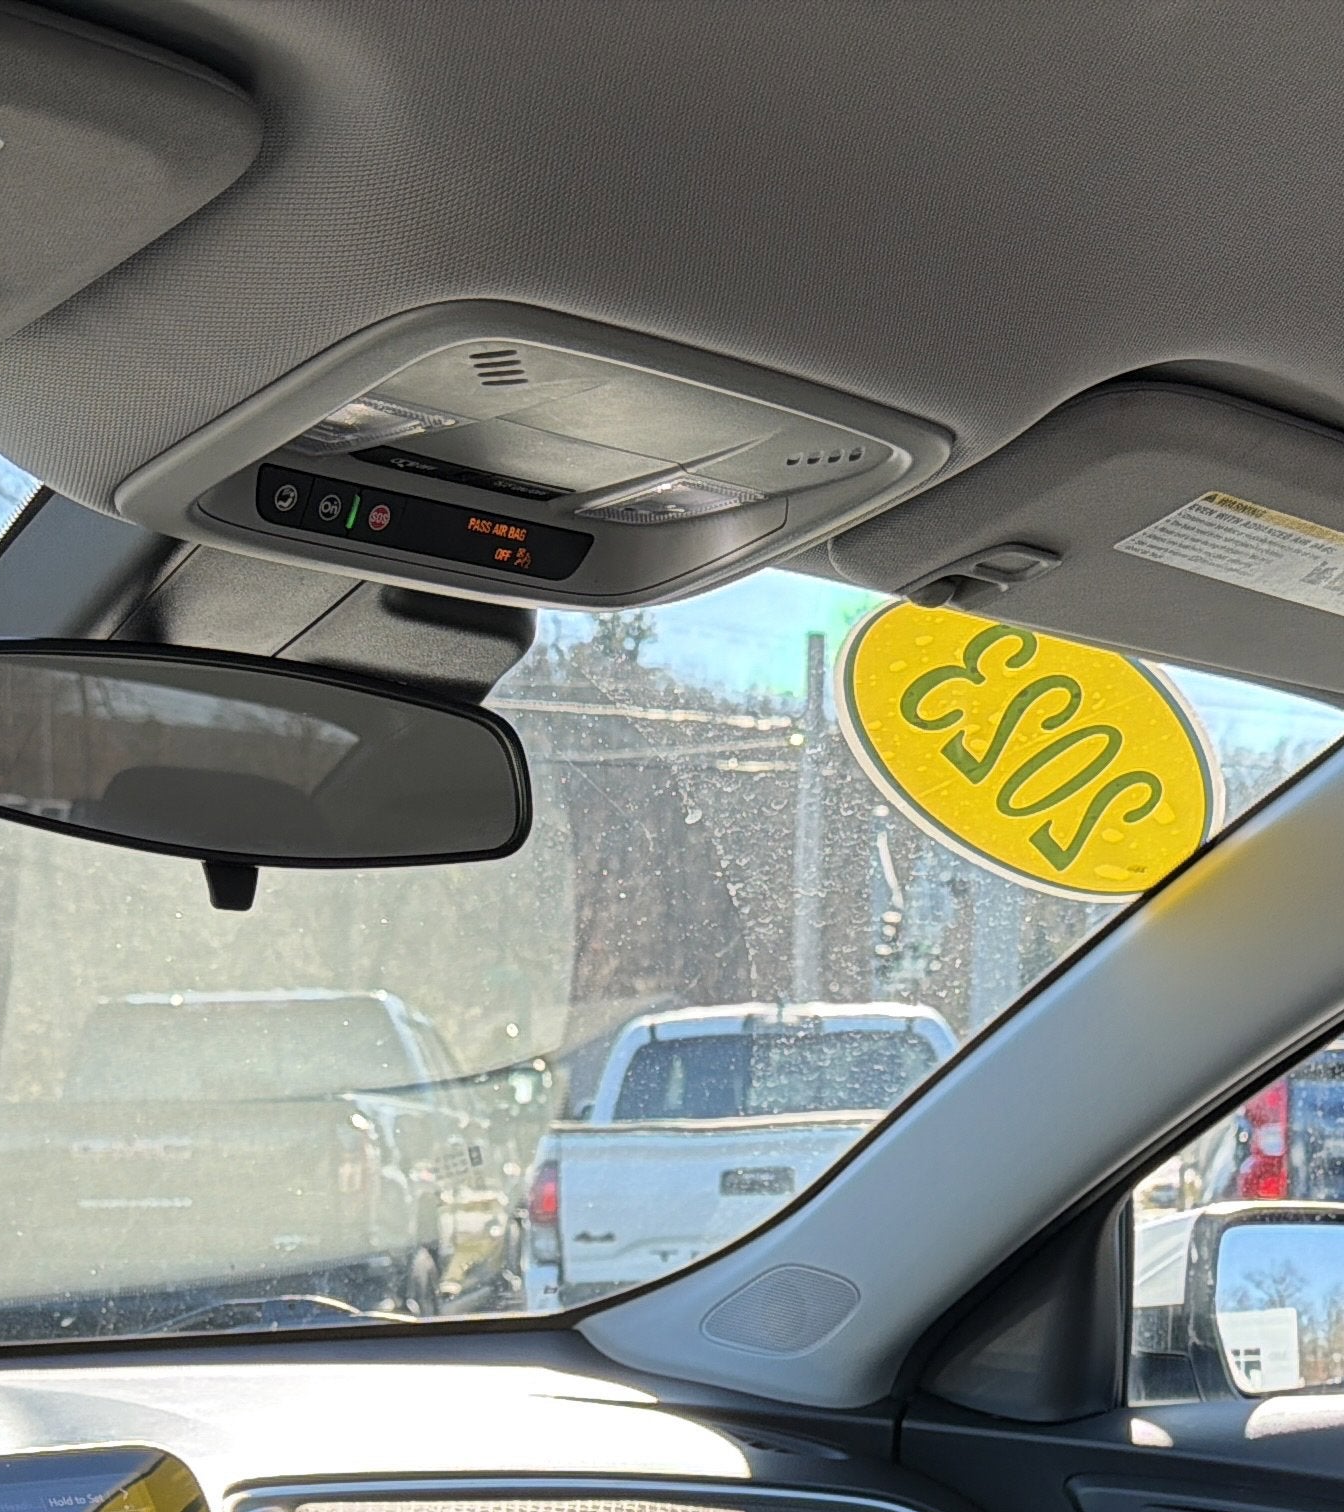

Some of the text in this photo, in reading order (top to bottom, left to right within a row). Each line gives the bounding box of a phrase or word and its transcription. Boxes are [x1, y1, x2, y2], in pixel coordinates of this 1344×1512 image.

[369, 511, 389, 524] SOS
[467, 517, 492, 533] PASS
[491, 523, 508, 538] AIR
[505, 526, 528, 542] BAG
[494, 548, 512, 562] OFF
[49, 1496, 74, 1508] Hold
[74, 1495, 87, 1505] to
[88, 1493, 104, 1504] Set
